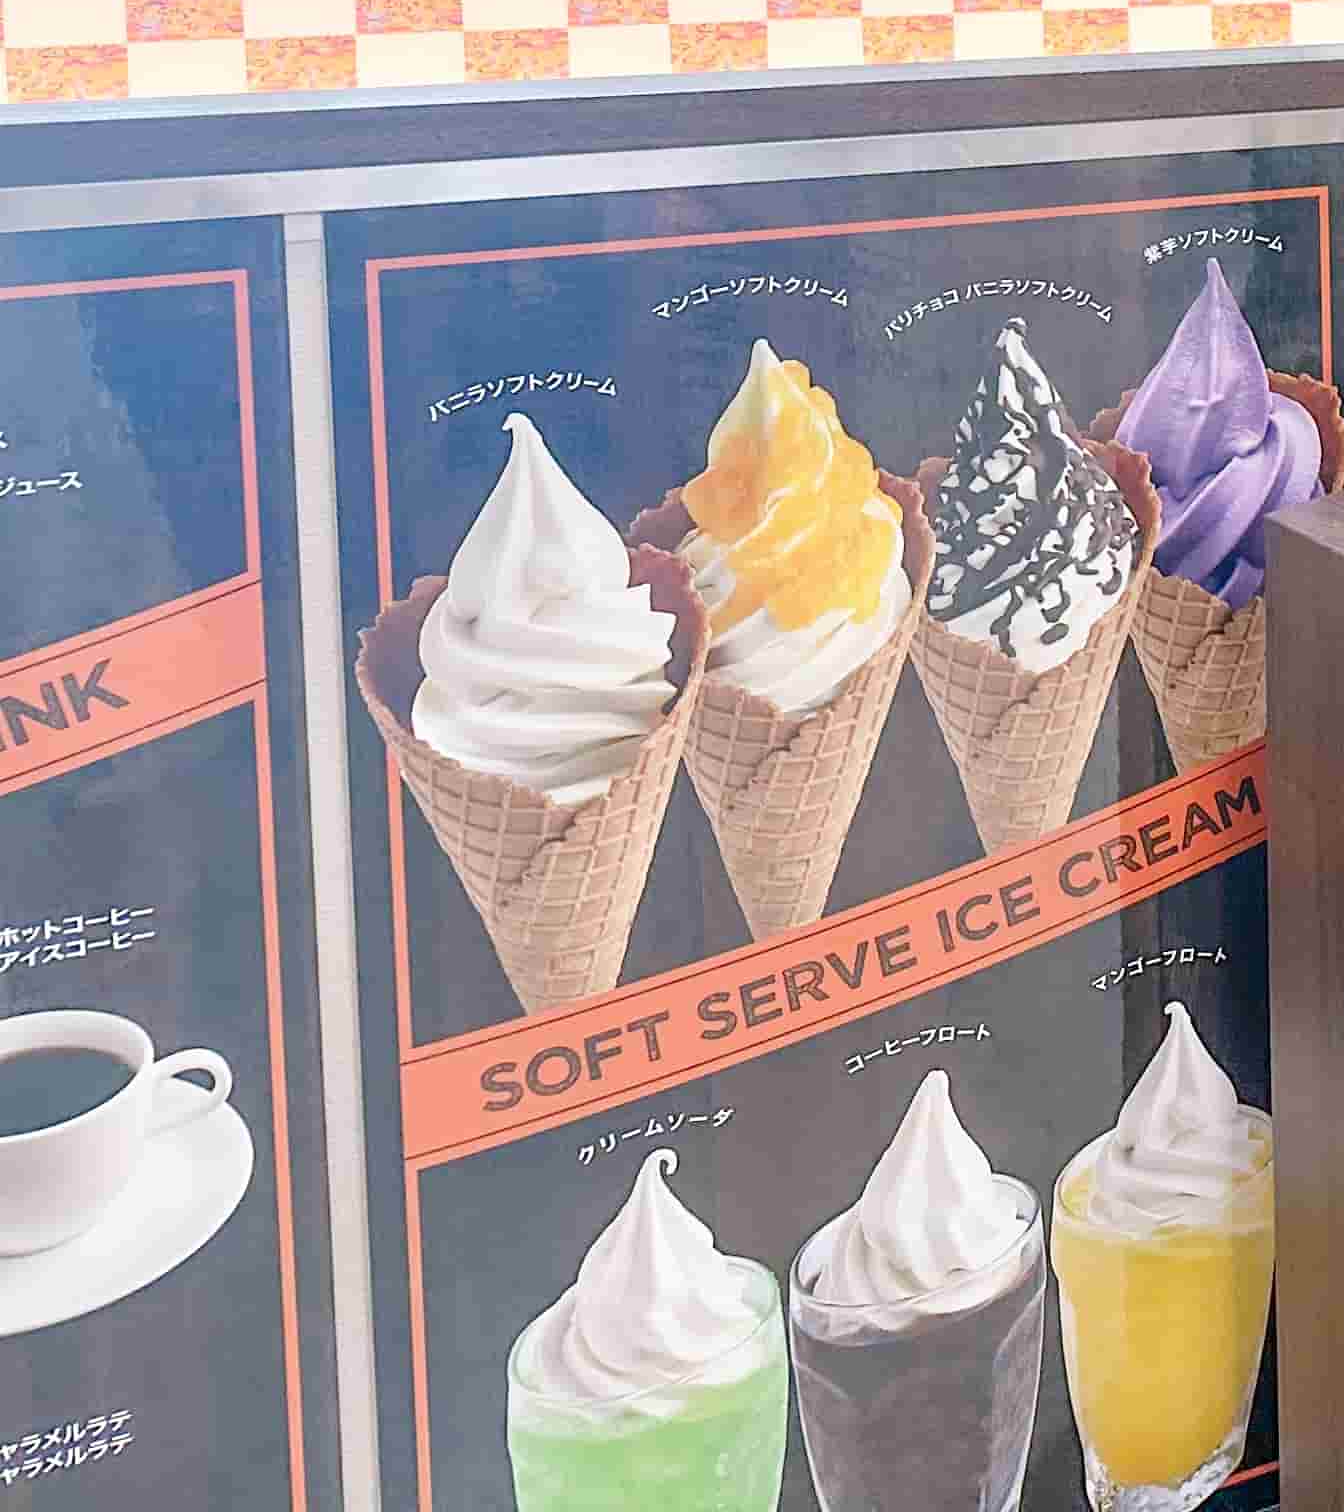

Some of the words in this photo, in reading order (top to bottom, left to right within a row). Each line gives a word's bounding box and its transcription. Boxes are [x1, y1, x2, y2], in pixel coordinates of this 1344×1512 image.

[1143, 227, 1284, 265] 紫芋ソフトクリーム
[651, 275, 849, 318] マンゴーソフトクリーム
[965, 279, 1113, 323] バニラソフトクリーム
[428, 371, 617, 422] バニラソフトクリーム
[0, 656, 131, 752] NK
[0, 907, 155, 948] ホットコーヒー
[479, 1010, 671, 1114] SOFT
[697, 926, 917, 1041] SERVE
[935, 875, 1042, 953] ICE
[1058, 774, 1263, 899] CREAM
[0, 931, 156, 974] アイスコーヒー
[1091, 945, 1228, 992] マンゴーフロート
[844, 1022, 992, 1076] コーヒーフロート
[578, 1107, 735, 1166] クリームソーダ
